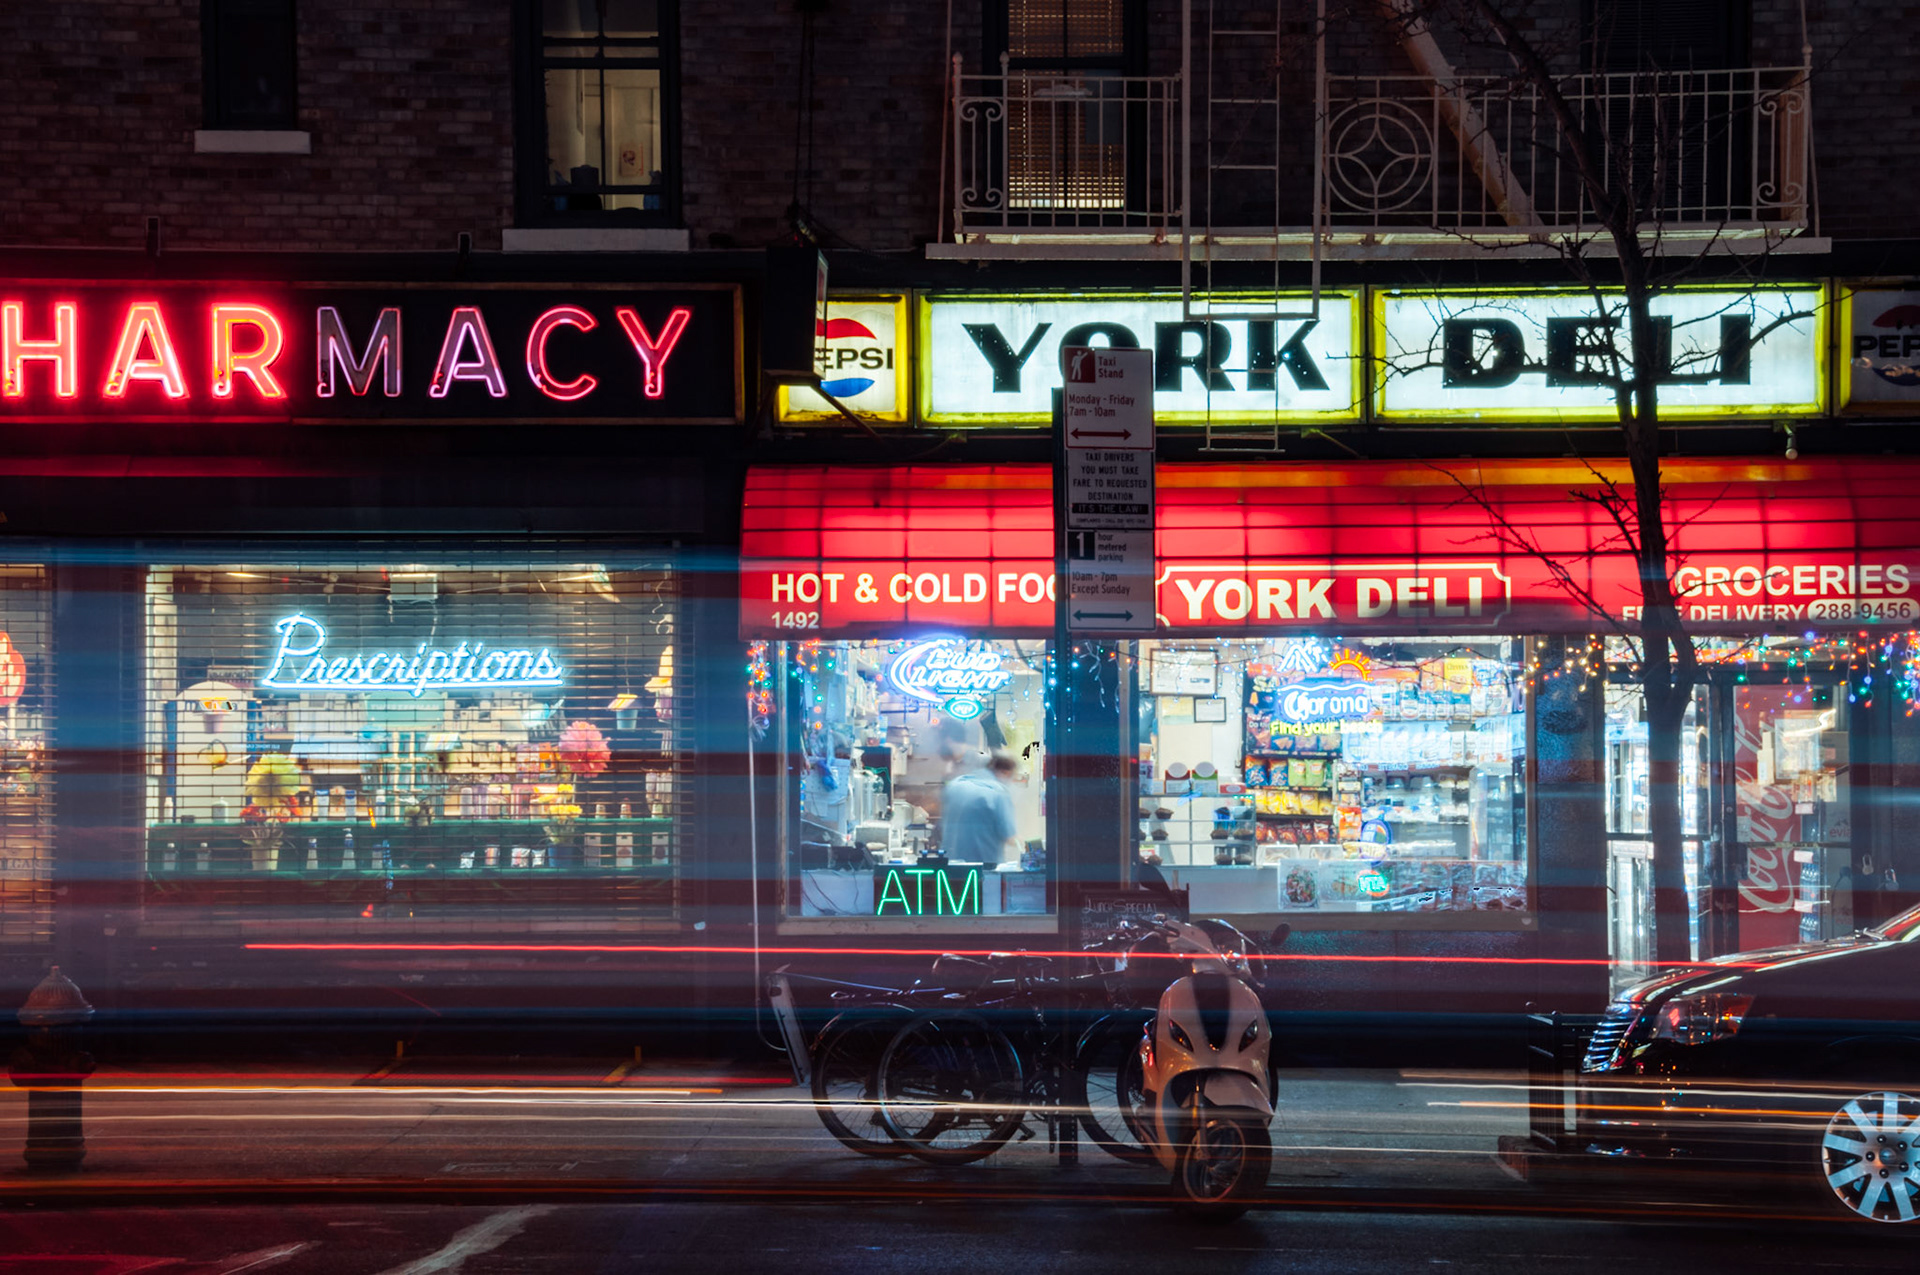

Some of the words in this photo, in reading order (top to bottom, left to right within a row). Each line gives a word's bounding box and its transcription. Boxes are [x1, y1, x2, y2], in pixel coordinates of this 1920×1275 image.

[815, 347, 894, 370] EPSI
[962, 319, 1331, 394] YORK
[1443, 314, 1751, 389] DELI
[1098, 356, 1117, 367] Taxi
[1098, 368, 1124, 379] Stand
[1068, 394, 1101, 406] Monday
[1109, 395, 1135, 407] Friday
[1069, 406, 1087, 416] 7am
[1094, 407, 1116, 417] 10am
[1085, 452, 1101, 461] TAXI
[1104, 452, 1135, 461] DRIVERS
[1081, 466, 1095, 475] YOU
[1098, 466, 1117, 475] MUST
[1121, 466, 1139, 475] TAKE
[1072, 478, 1091, 488] FARE
[1095, 479, 1104, 488] TO
[1106, 479, 1148, 489] REQUESTED
[1088, 491, 1134, 501] DESTINATION
[1099, 504, 1116, 513] THE
[1097, 533, 1114, 541] hour
[1076, 532, 1085, 557] 1
[1097, 543, 1127, 552] metered
[1098, 553, 1124, 562] parking
[1072, 571, 1093, 581] 10am
[1101, 571, 1118, 582] 7pm
[1675, 564, 1910, 597] GROCERIES
[771, 573, 845, 604] HOT
[854, 572, 880, 604] &
[888, 573, 987, 604] COLD
[1071, 583, 1099, 595] Except
[1101, 583, 1131, 596] Sunday
[1174, 577, 1338, 620] YORK
[1356, 576, 1483, 619] DELI
[1690, 604, 1806, 622] DELIVERY
[1815, 601, 1912, 620] 288-9456
[771, 611, 820, 630] 1492
[262, 612, 564, 697] Prescriptions
[1283, 691, 1370, 721] Corona
[1269, 721, 1302, 735] Find
[1303, 721, 1338, 737] your
[1829, 826, 1851, 838] evia
[877, 868, 980, 916] ATM
